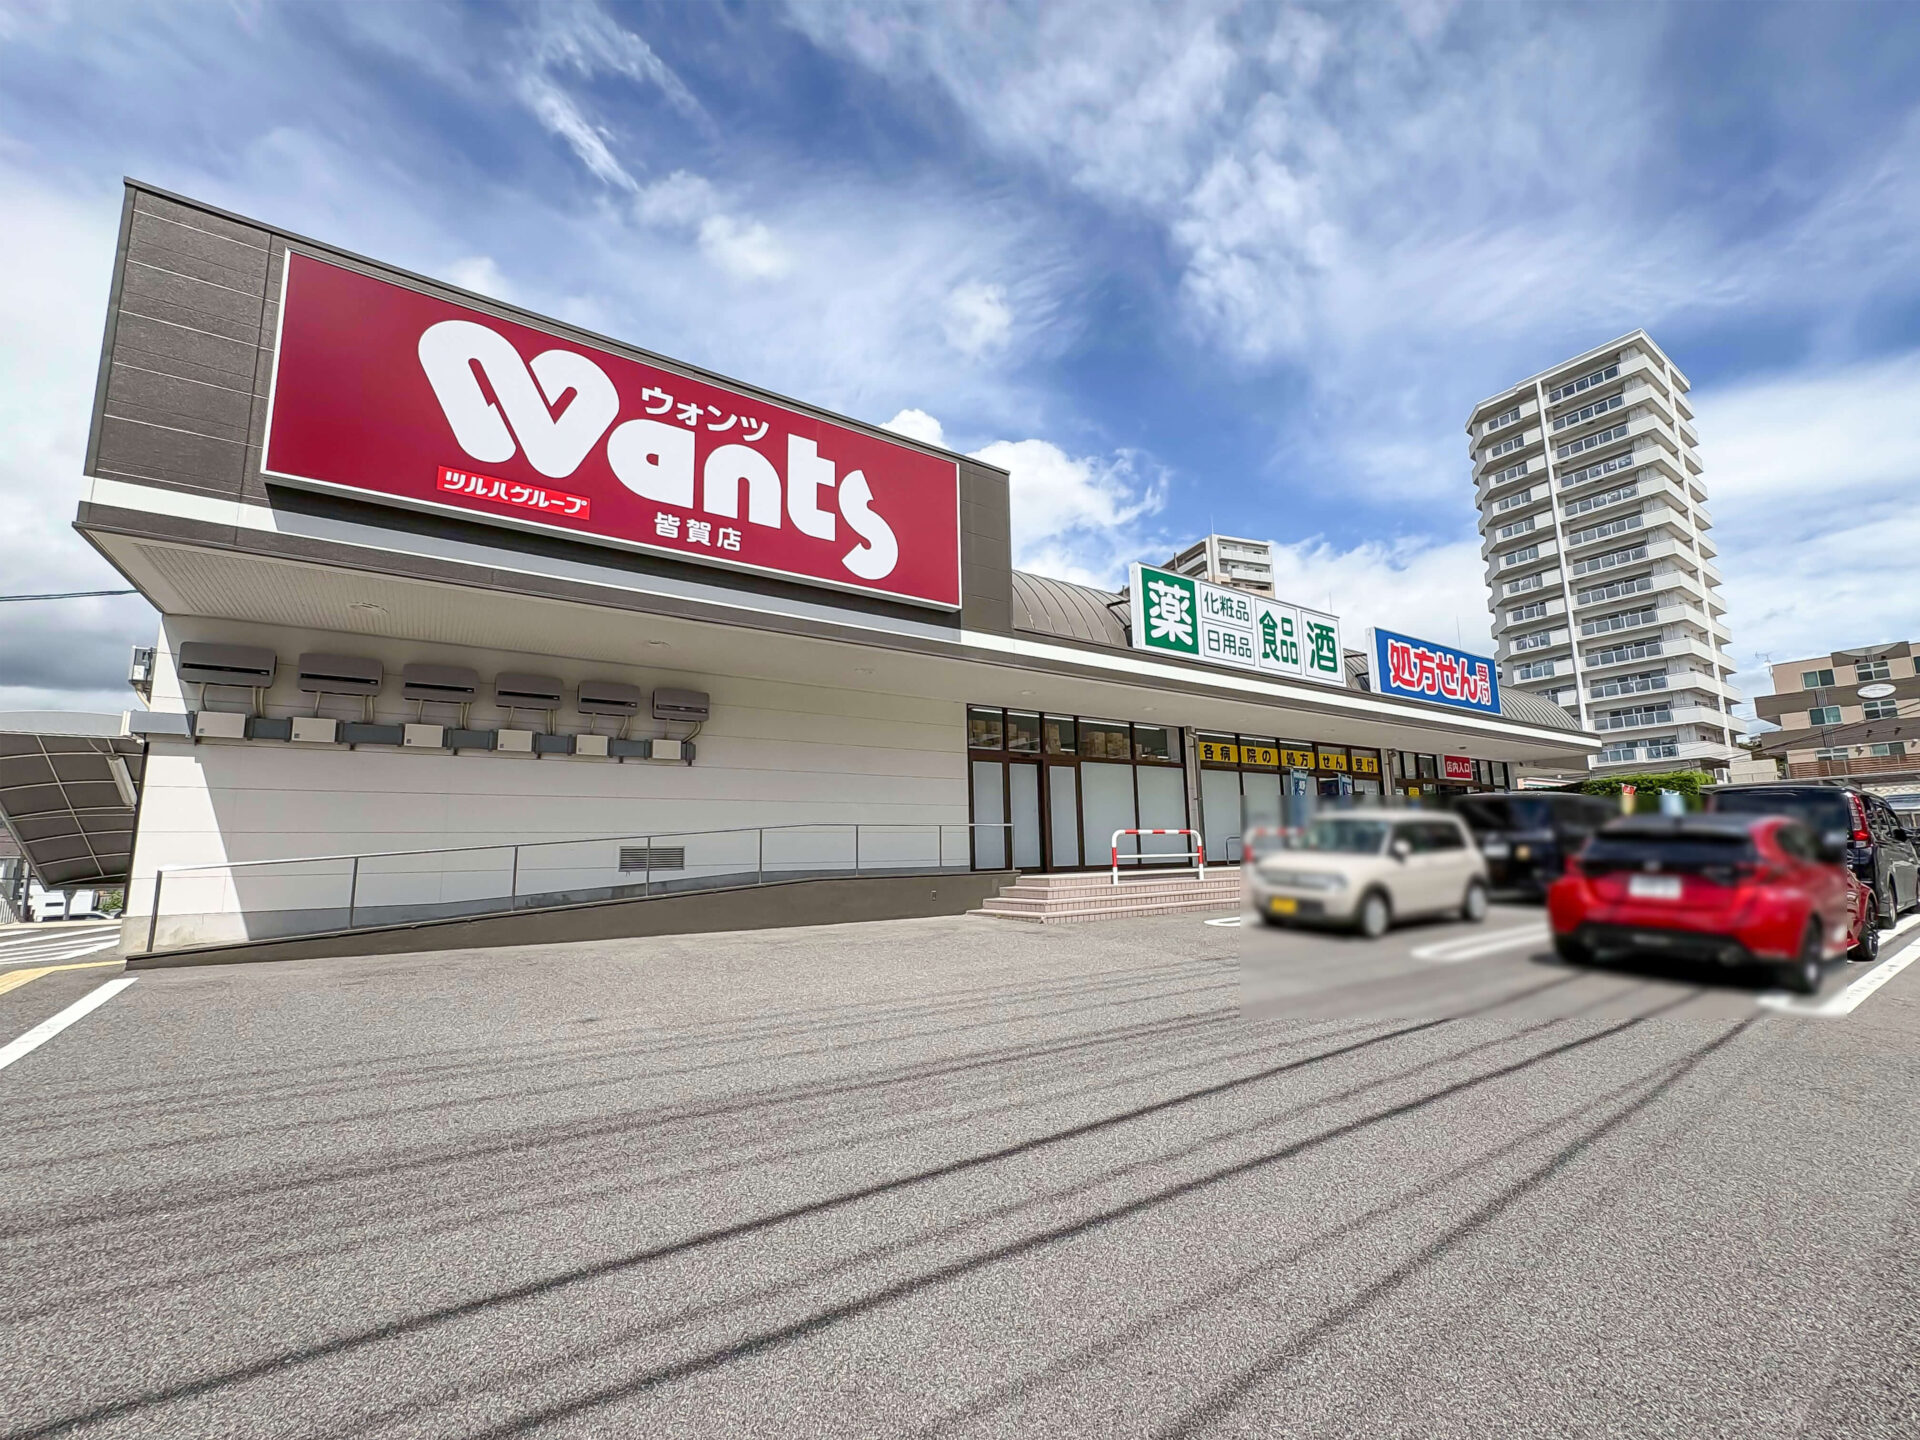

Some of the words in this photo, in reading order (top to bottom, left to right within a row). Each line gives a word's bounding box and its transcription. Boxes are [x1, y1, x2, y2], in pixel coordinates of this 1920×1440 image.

[642, 387, 770, 442] ウォンツ
[418, 319, 898, 580] Wants
[444, 471, 588, 514] ツルハグループ
[655, 511, 742, 552] 皆賀店
[1148, 580, 1193, 646] 薬
[1204, 591, 1249, 622] 化粧品
[1207, 629, 1252, 658] 日用品
[1259, 609, 1298, 665] 食品
[1306, 620, 1337, 673] 酒
[1389, 641, 1478, 701] 処方せん
[1477, 664, 1491, 704] 受付
[1446, 761, 1471, 773] 店内入口
